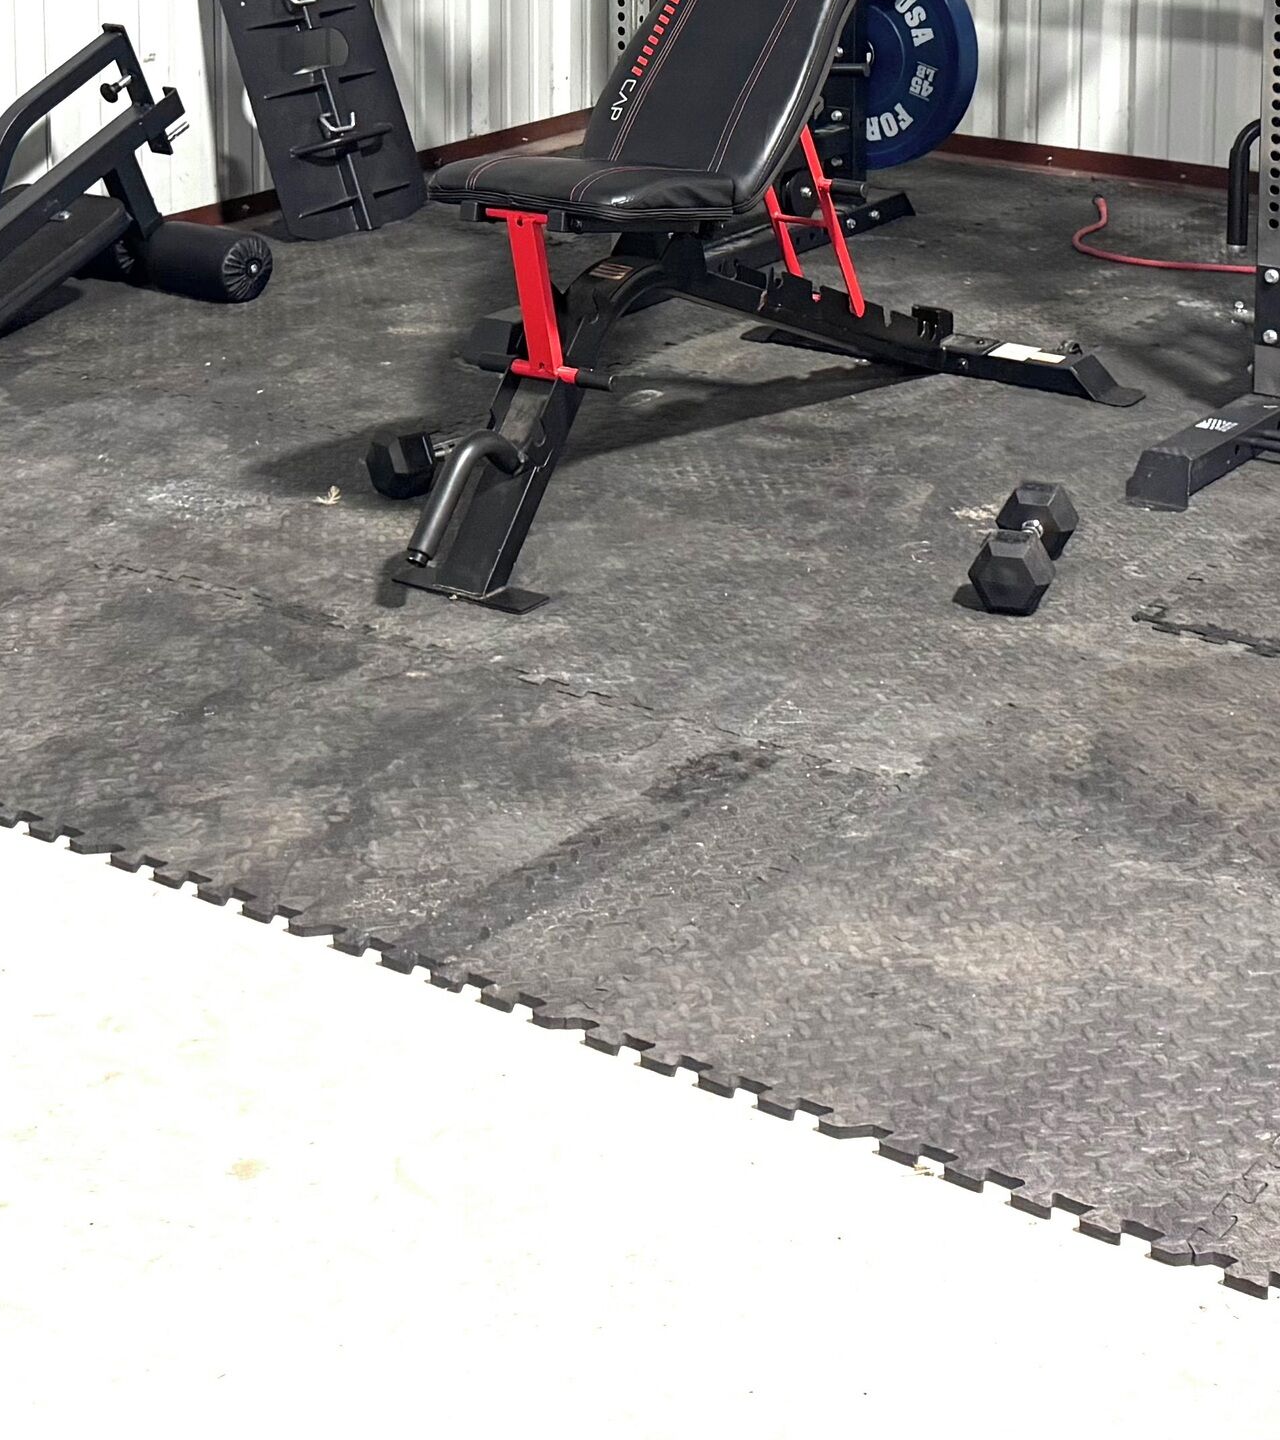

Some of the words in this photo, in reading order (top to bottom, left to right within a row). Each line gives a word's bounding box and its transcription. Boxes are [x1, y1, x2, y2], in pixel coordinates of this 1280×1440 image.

[909, 76, 934, 98] 45
[915, 63, 937, 83] LB
[610, 78, 637, 121] CAP
[866, 103, 914, 142] FOR
